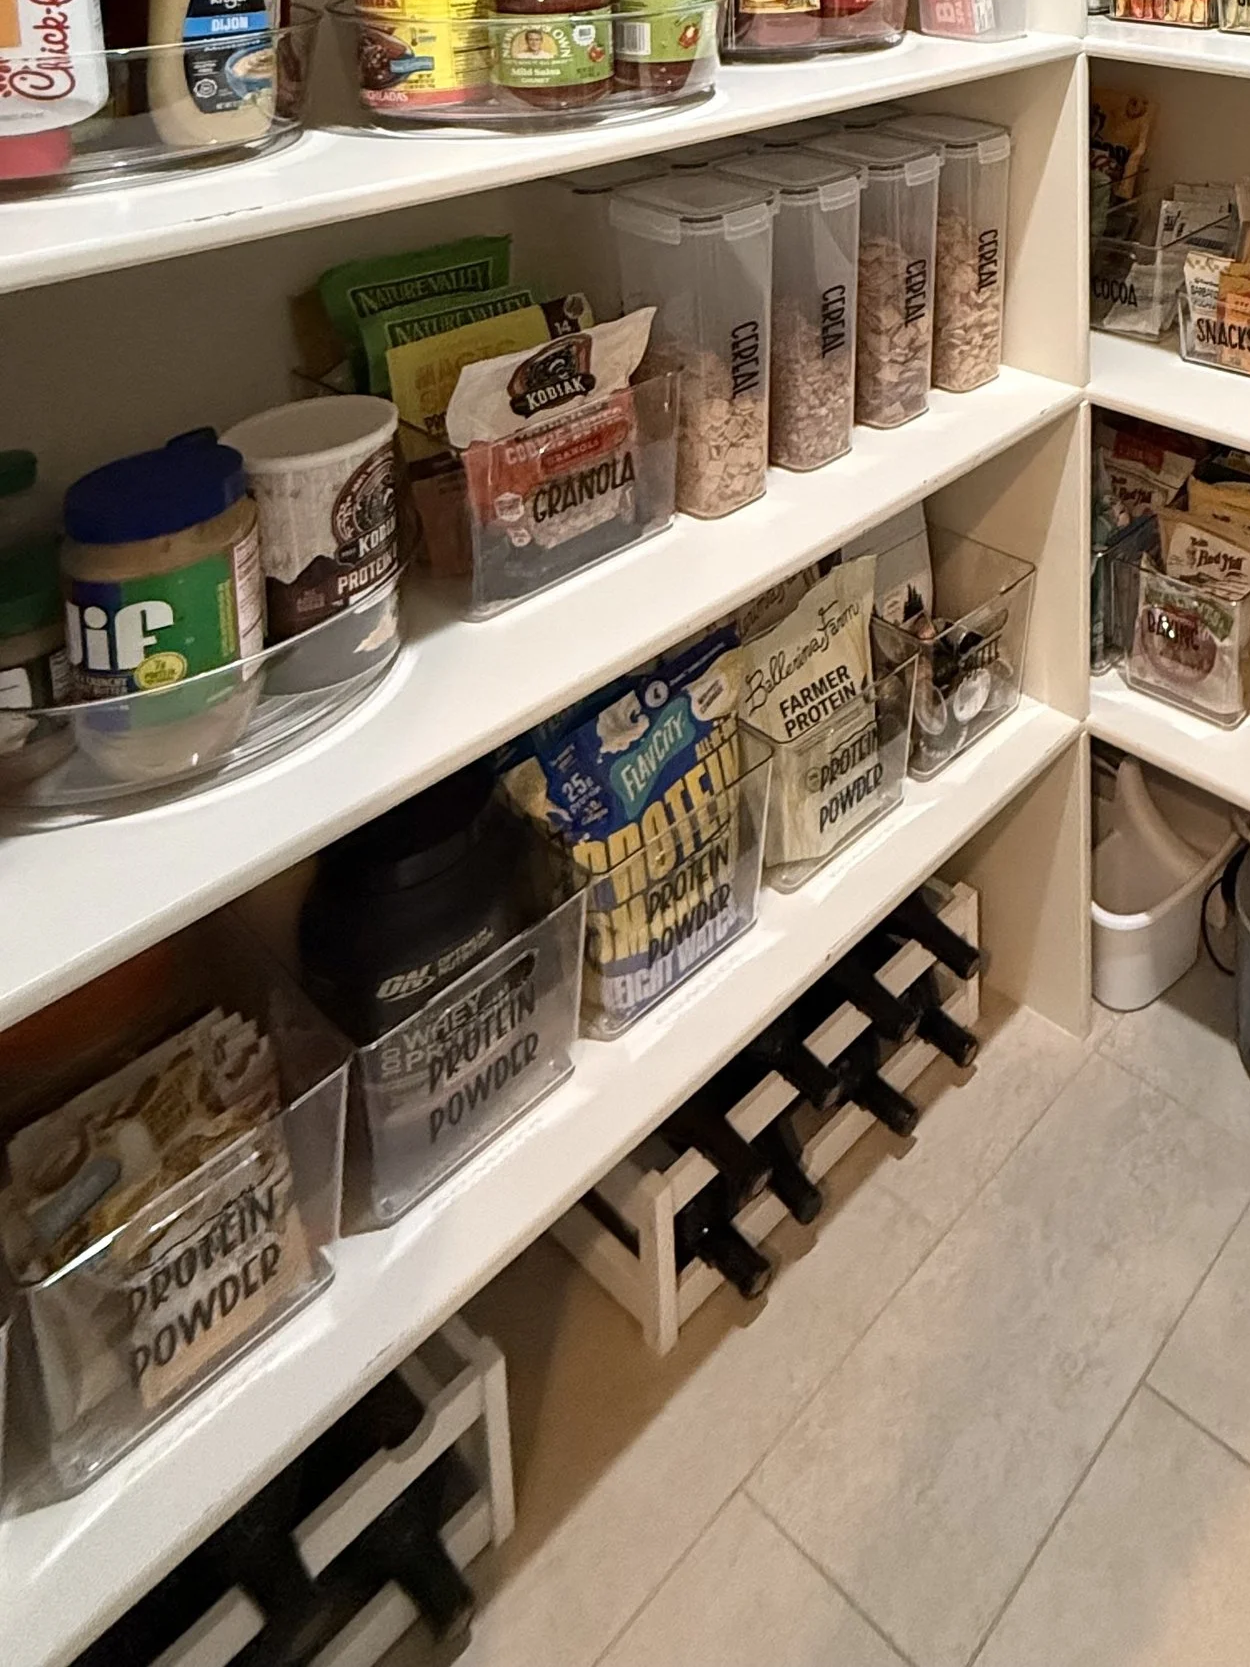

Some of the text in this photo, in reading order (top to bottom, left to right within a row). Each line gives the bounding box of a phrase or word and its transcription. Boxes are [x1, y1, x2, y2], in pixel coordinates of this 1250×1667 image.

[211, 16, 249, 32] DIJON
[552, 29, 573, 59] OWN
[356, 263, 491, 316] NATURE VALLEY
[905, 259, 927, 328] CEREAL
[978, 229, 998, 291] CEREAL
[1093, 280, 1138, 308] COCOA
[821, 284, 846, 359] CEREAL
[526, 375, 586, 412] KODIAK
[732, 320, 759, 399] CEREAL
[532, 450, 636, 524] GRANOLA
[1197, 549, 1247, 573] Red Mill
[779, 664, 852, 720] FARMER
[784, 680, 858, 739] PROTEIN
[620, 709, 687, 803] FLAVCITY
[820, 725, 880, 793] PROTEIN
[819, 764, 884, 833] POWDER
[644, 842, 730, 925] PROTEIN
[648, 883, 731, 969] POWDER
[429, 981, 537, 1094] PROTEIN
[429, 1032, 539, 1144] POWDER
[124, 1180, 281, 1324] PROTEIN
[130, 1243, 282, 1385] POWDER
